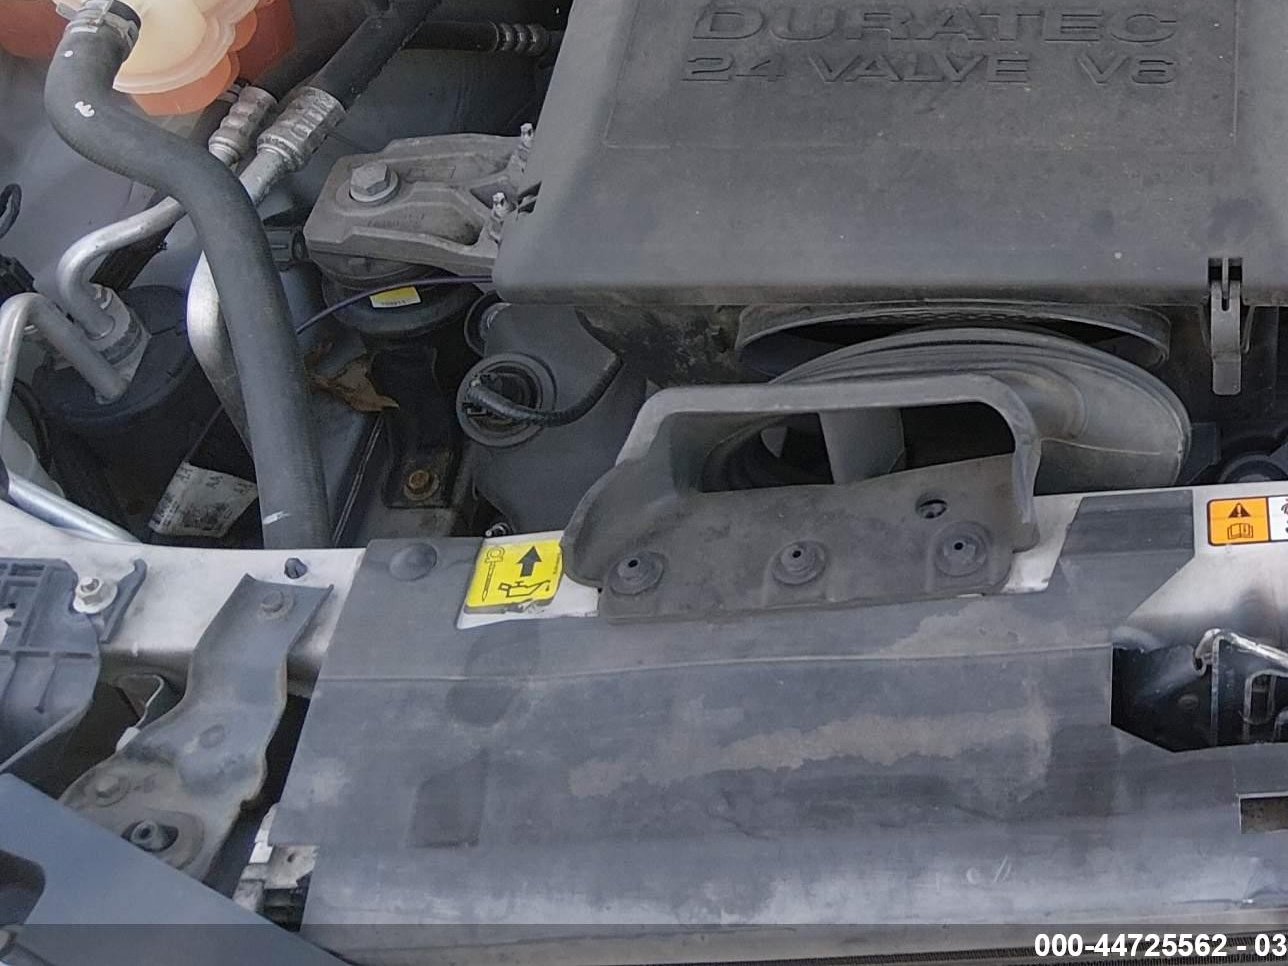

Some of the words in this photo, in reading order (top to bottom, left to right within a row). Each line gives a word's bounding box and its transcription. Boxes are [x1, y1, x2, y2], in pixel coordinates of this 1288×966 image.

[692, 8, 1178, 43] DURATEC
[680, 53, 785, 82] 24
[807, 53, 1030, 82] VALVE
[1075, 53, 1177, 84] V6
